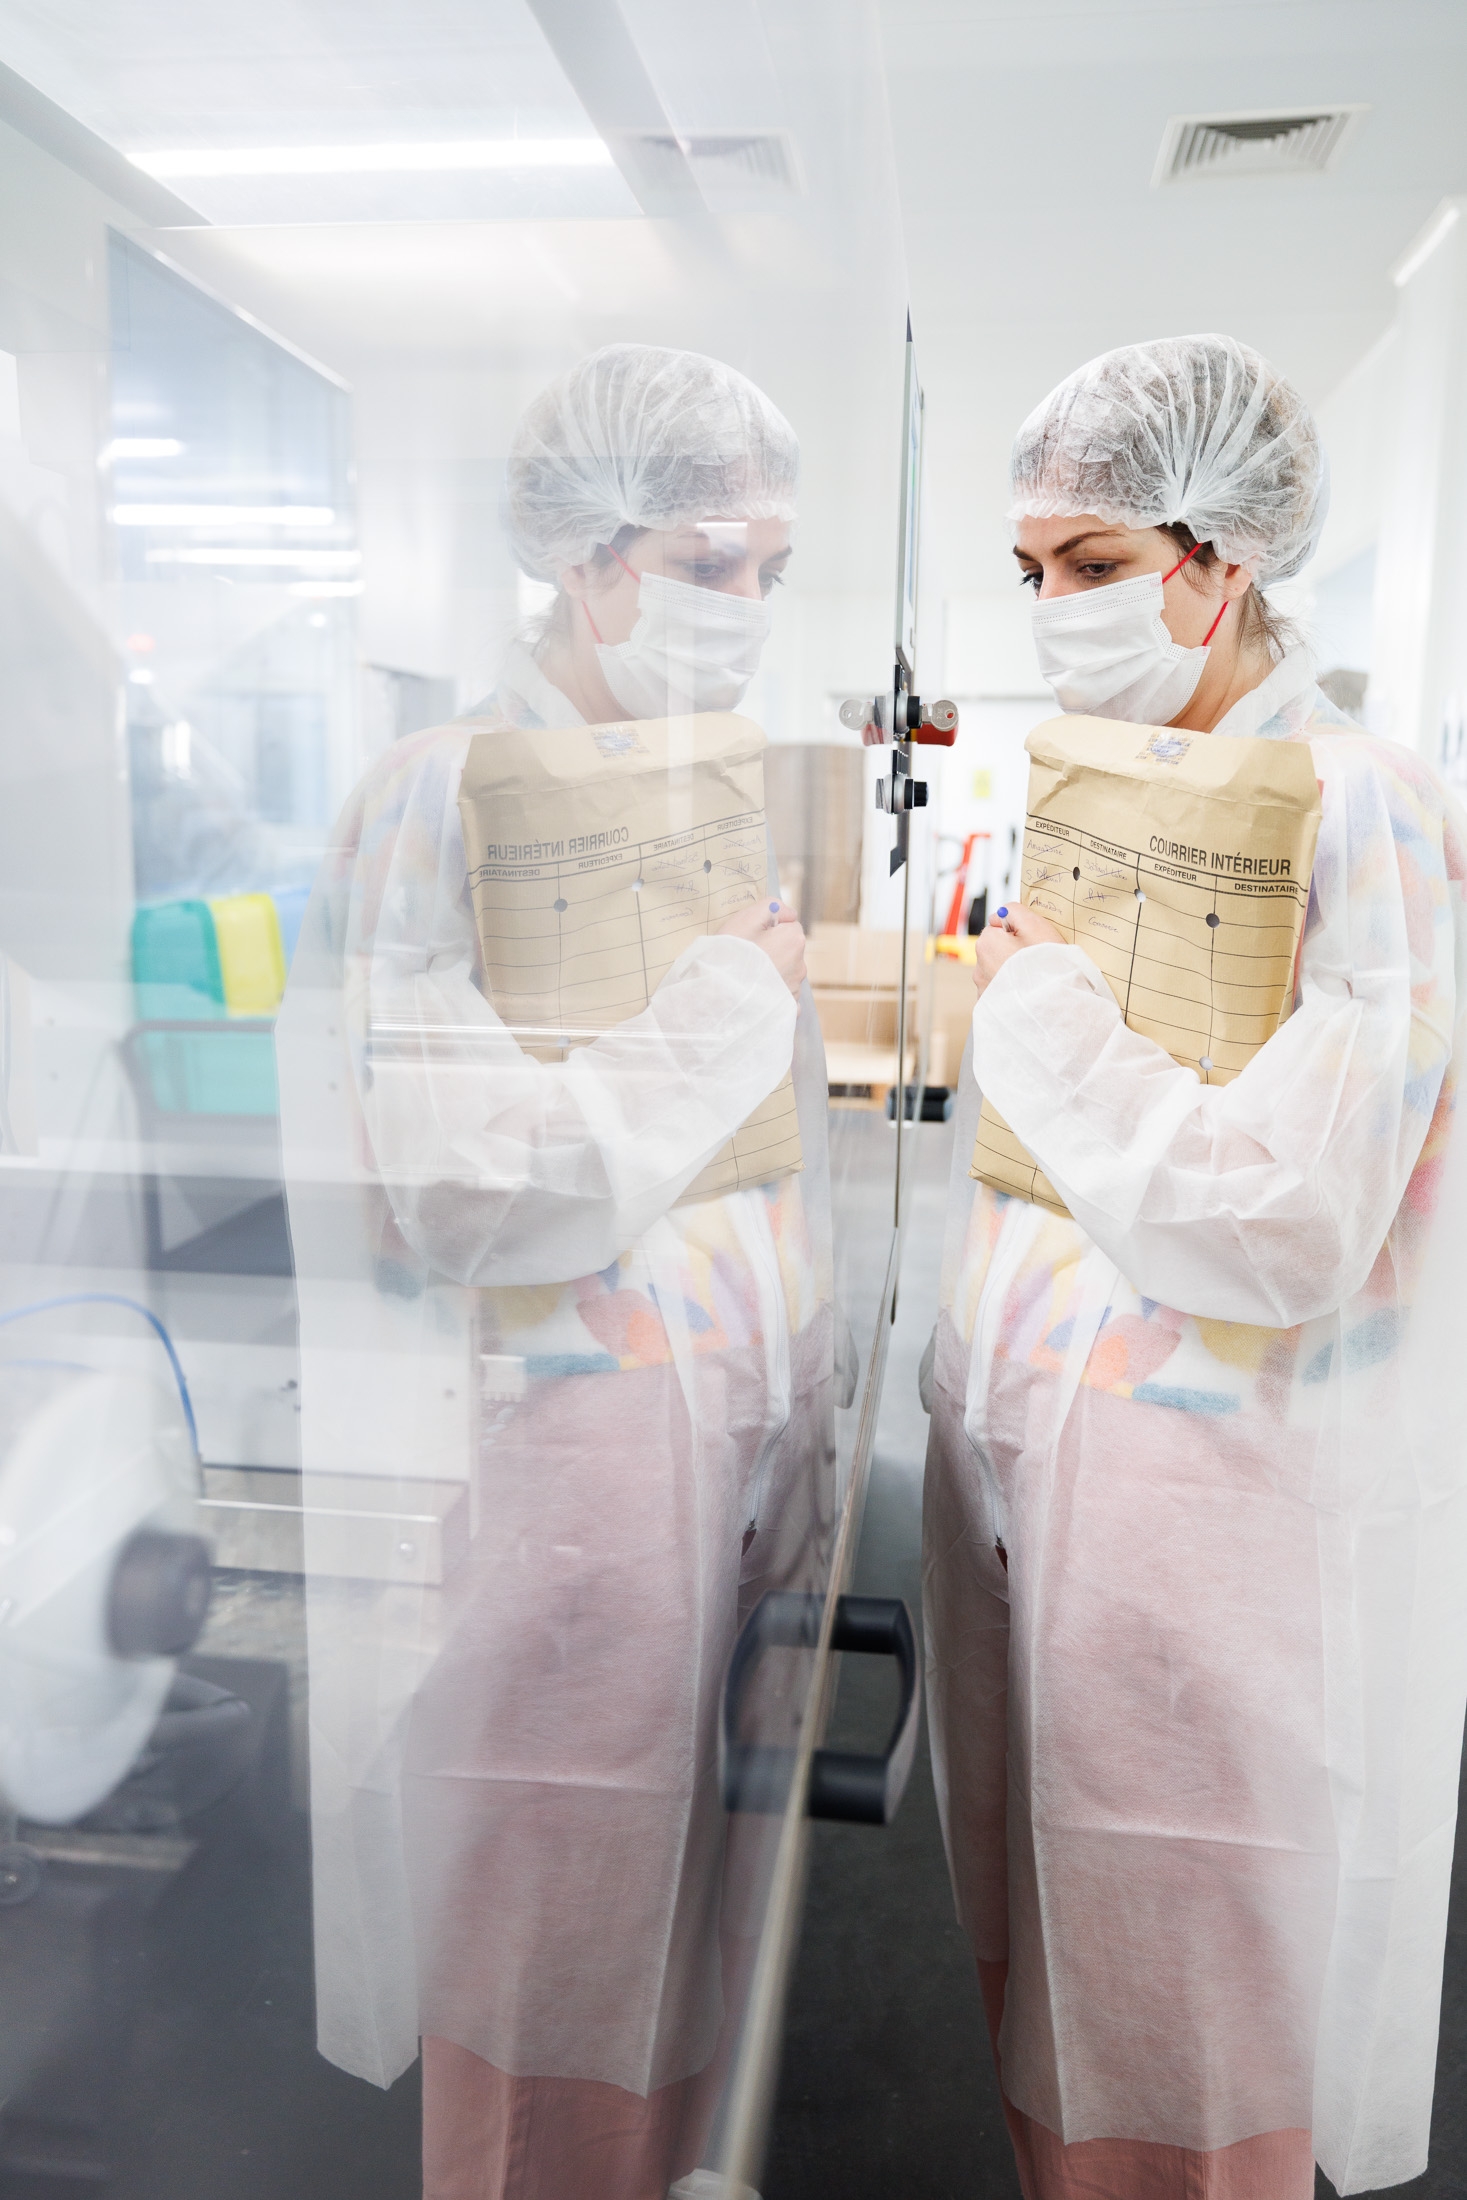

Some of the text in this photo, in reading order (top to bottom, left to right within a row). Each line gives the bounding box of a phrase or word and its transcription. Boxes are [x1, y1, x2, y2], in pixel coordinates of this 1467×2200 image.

[1035, 820, 1070, 837] EXPÉDITEUR
[1090, 839, 1127, 860] DESTINATAIRE
[1150, 835, 1291, 876] COURRIER INTÉRIEUR
[1154, 863, 1197, 882] EXPÉDITEUR
[1234, 882, 1299, 895] DESTINATAIRE
